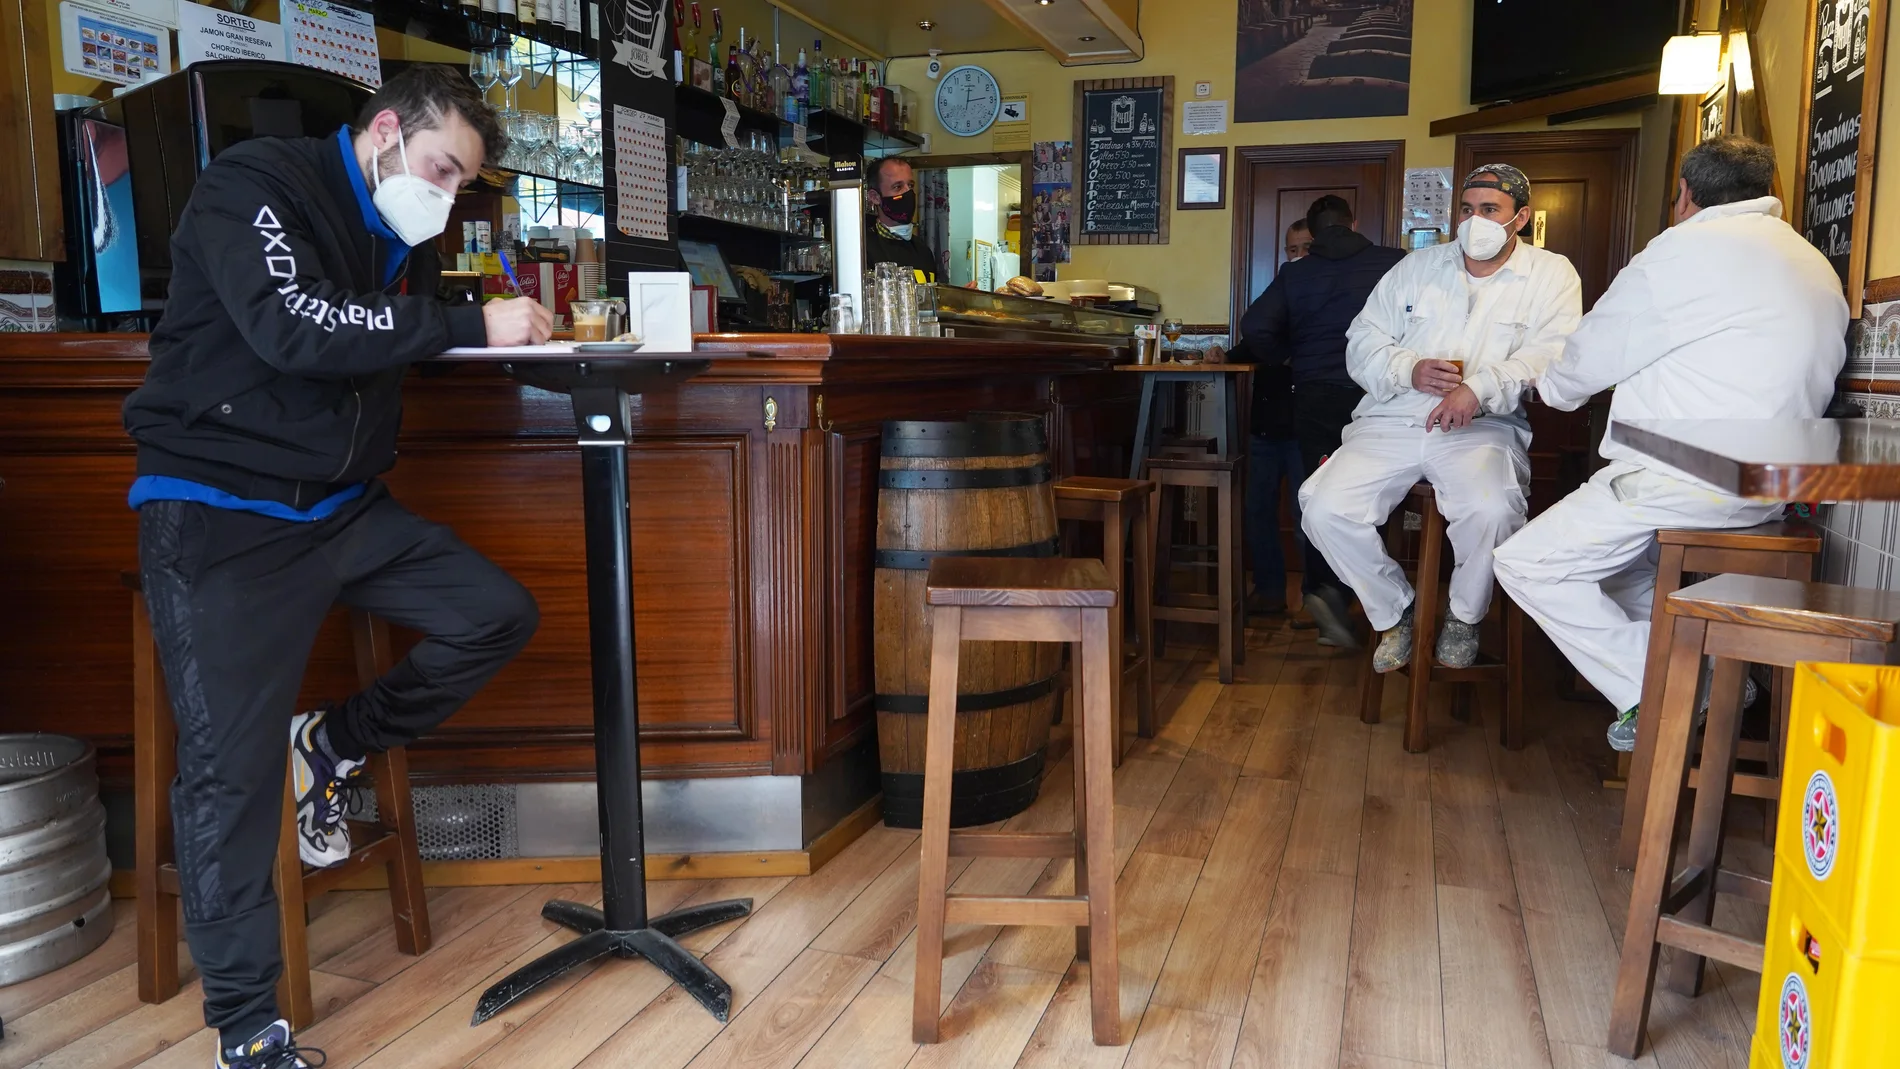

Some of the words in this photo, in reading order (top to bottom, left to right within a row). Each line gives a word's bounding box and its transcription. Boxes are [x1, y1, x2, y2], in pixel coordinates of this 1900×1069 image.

[217, 13, 256, 30] SORTEO
[200, 27, 225, 37] JAMON
[225, 32, 244, 41] GRAN
[245, 36, 272, 48] RESERVA
[211, 43, 241, 54] CHORIZO
[242, 50, 266, 60] IBERICO
[1090, 140, 1124, 149] Sardinas
[1090, 150, 1114, 160] Callos
[1089, 160, 1119, 169] Morro
[1089, 168, 1113, 183] Oreja
[1087, 190, 1113, 200] Pincho
[1116, 190, 1144, 199] Tortilla
[1087, 200, 1124, 210] Cortezas
[1087, 210, 1122, 220] Embutido
[277, 278, 395, 332] PlayStation
